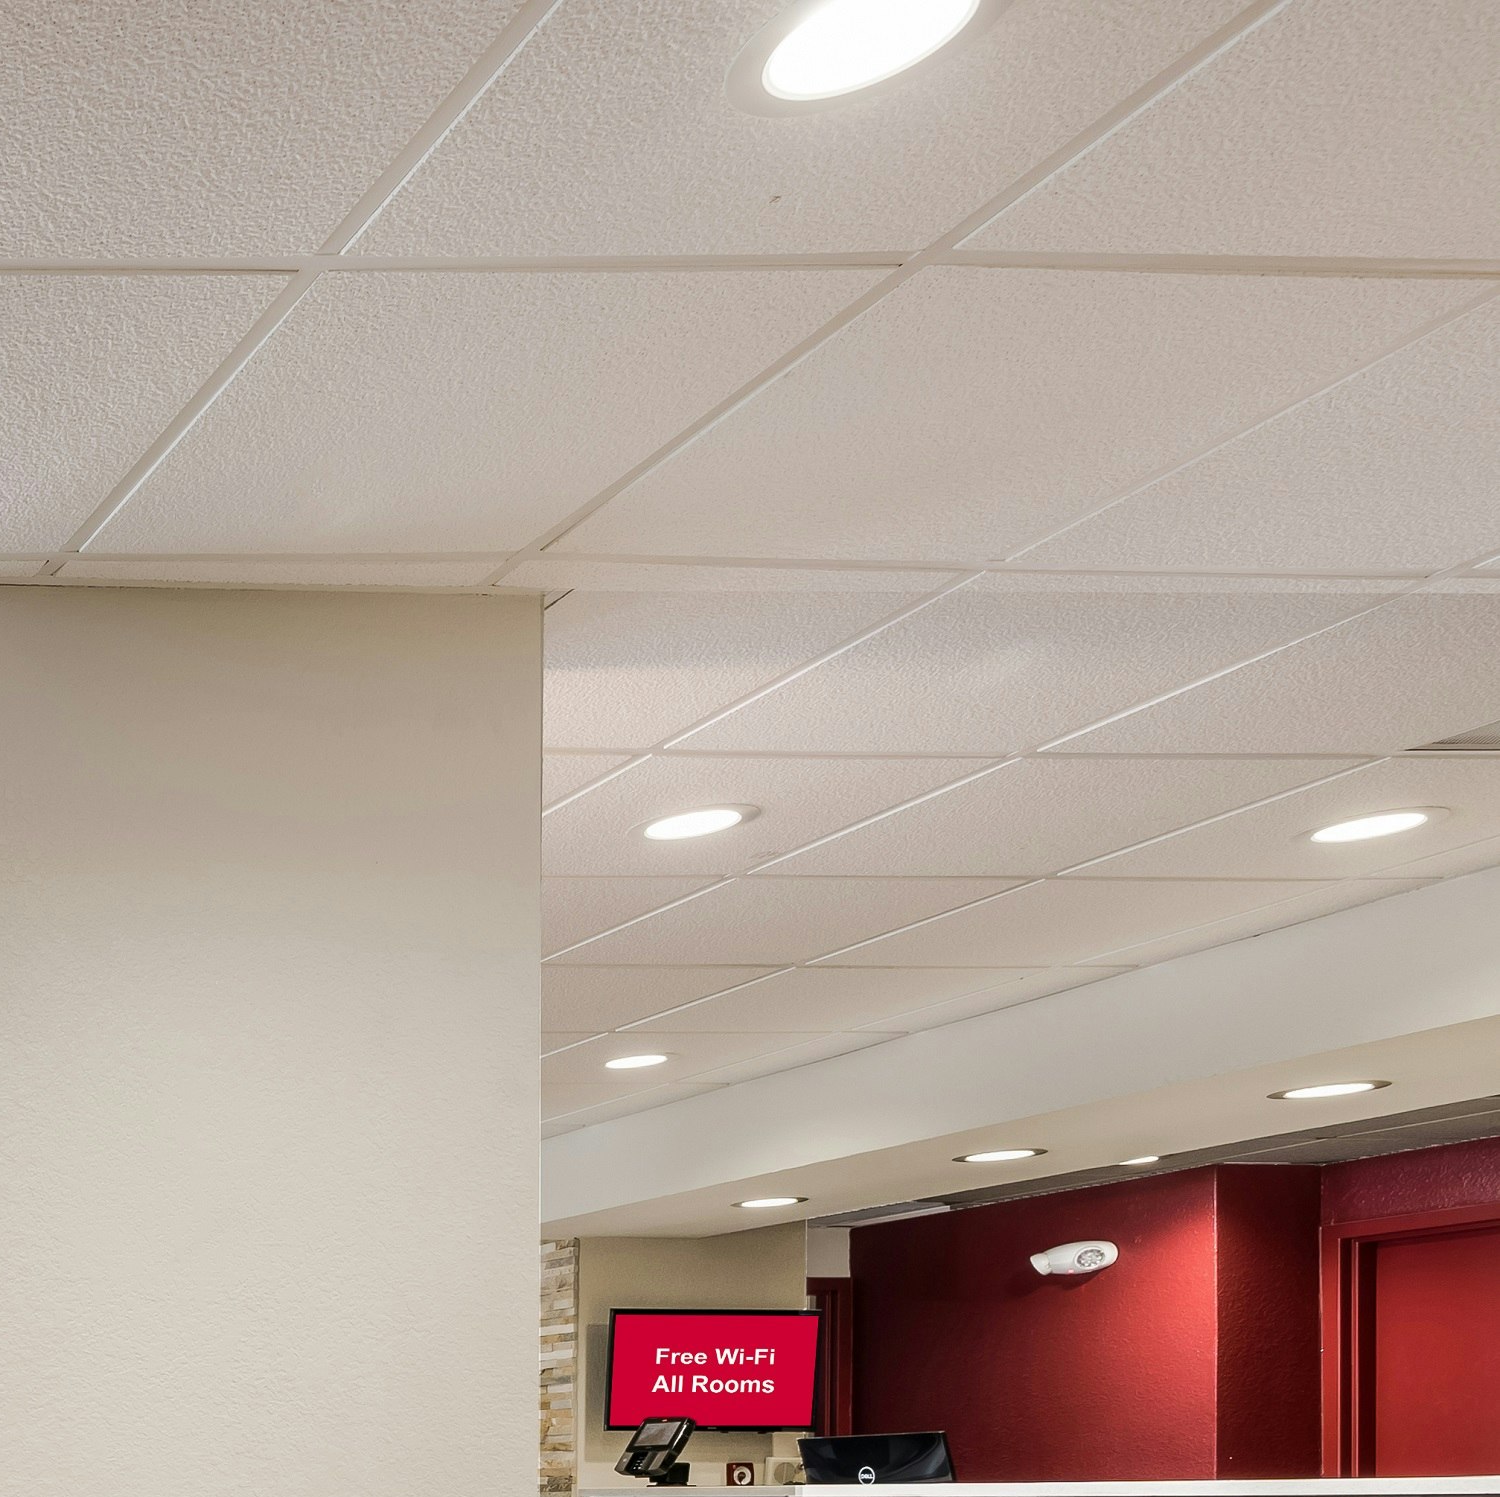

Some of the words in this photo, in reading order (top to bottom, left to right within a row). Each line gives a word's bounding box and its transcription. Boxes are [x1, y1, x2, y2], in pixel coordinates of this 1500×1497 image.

[655, 1347, 708, 1366] Free
[715, 1348, 776, 1366] Wi-Fi
[651, 1374, 684, 1393] All
[691, 1374, 775, 1395] Rooms
